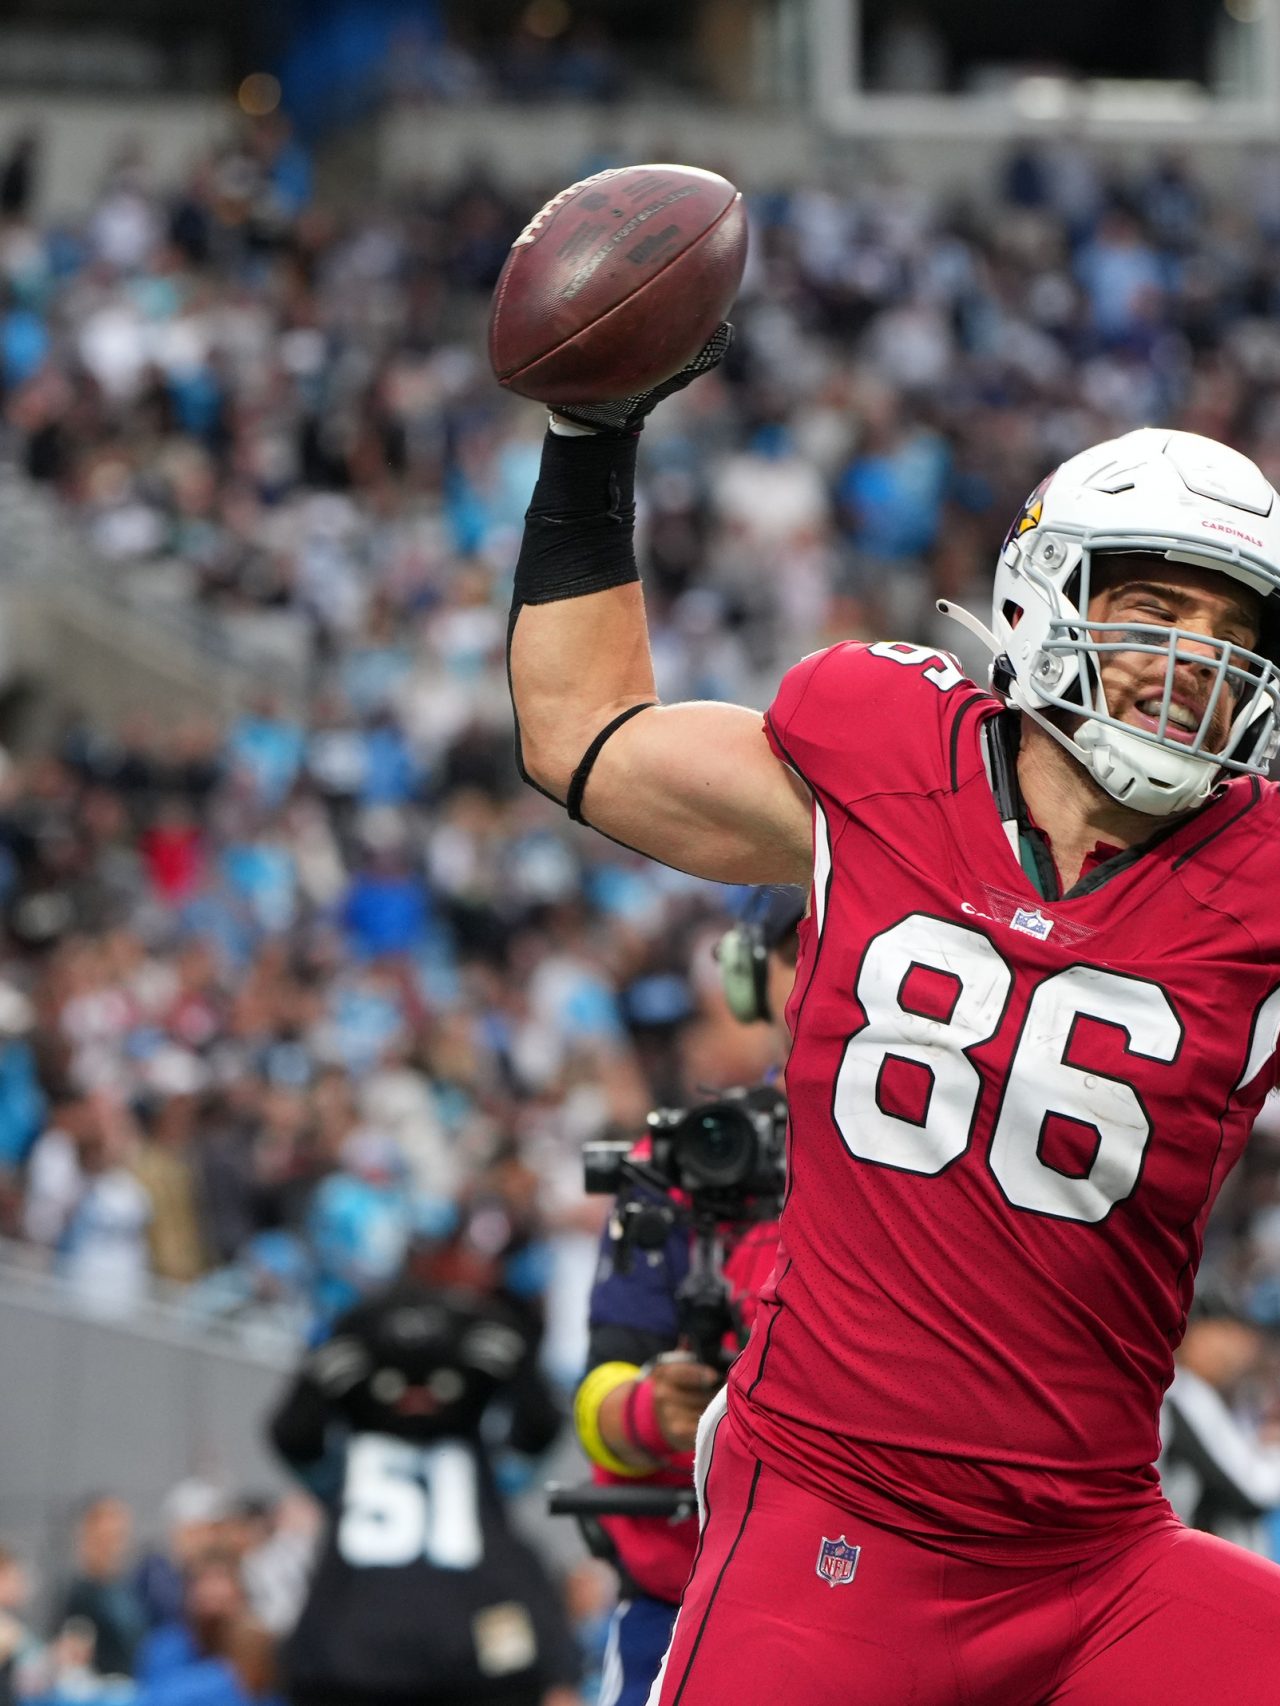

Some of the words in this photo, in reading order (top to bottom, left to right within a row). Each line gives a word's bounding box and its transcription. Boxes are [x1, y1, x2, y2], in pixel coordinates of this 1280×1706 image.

[1201, 520, 1263, 547] CARDINALS
[833, 911, 1185, 1224] 86
[337, 1432, 485, 1571] 51
[823, 1556, 849, 1577] NFL
